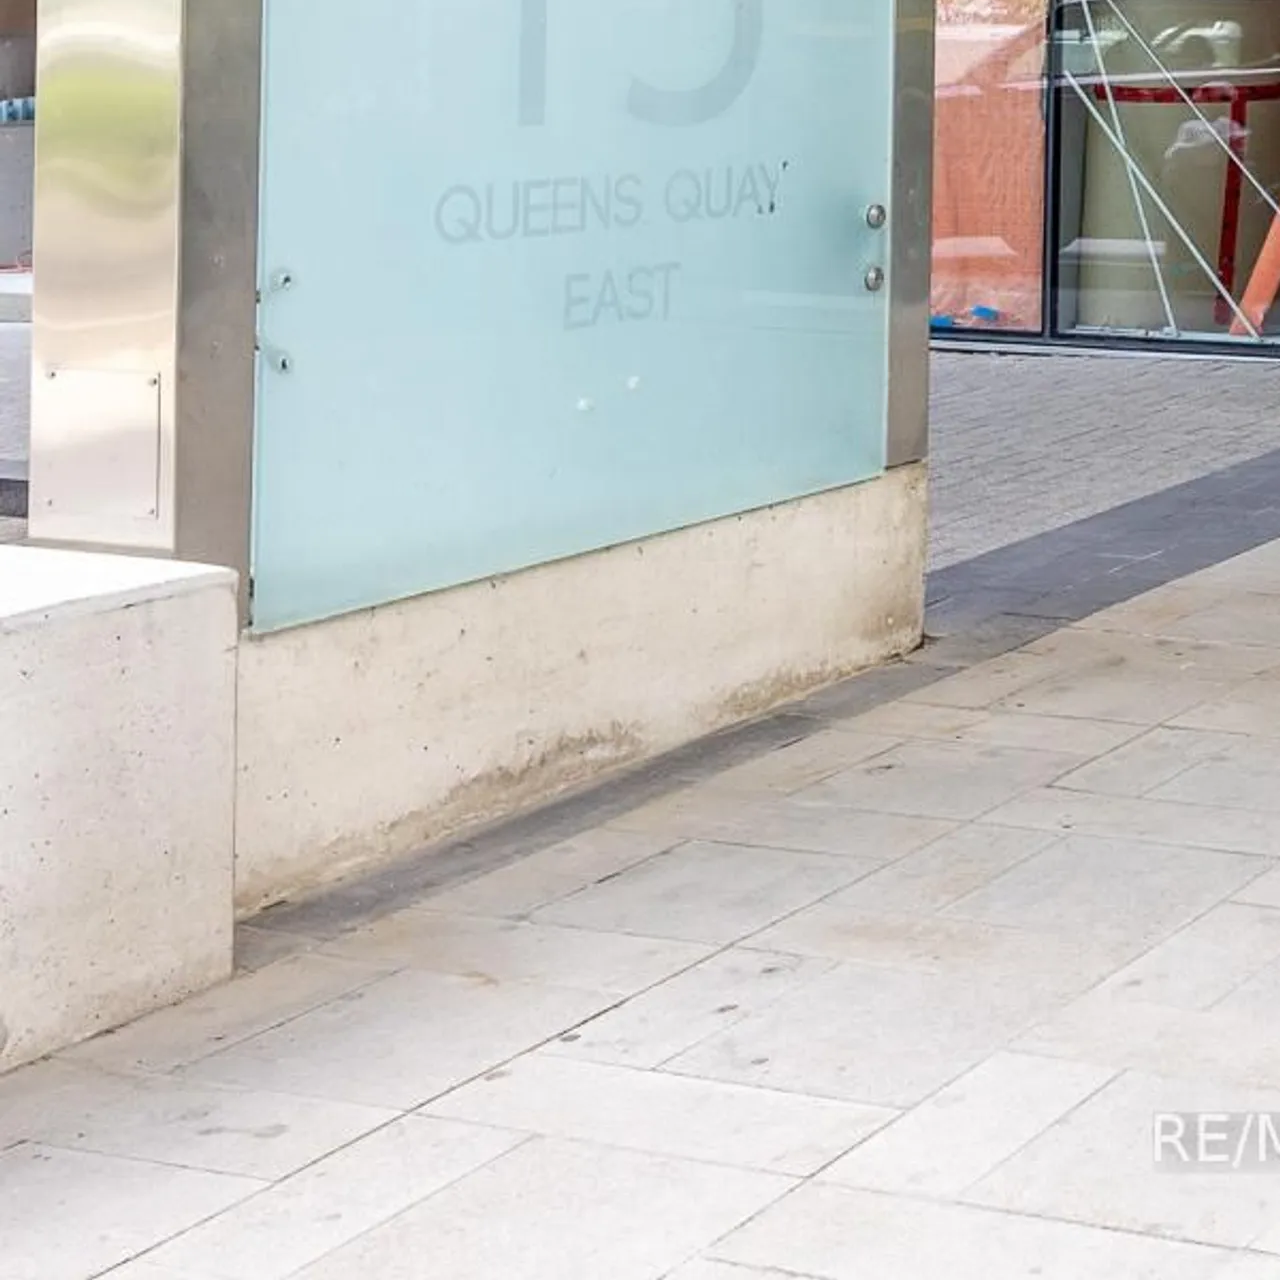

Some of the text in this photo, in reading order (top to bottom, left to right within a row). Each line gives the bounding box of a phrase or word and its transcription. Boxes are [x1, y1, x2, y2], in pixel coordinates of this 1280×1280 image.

[434, 163, 782, 246] QUEENS QUAY
[563, 262, 681, 331] EAST
